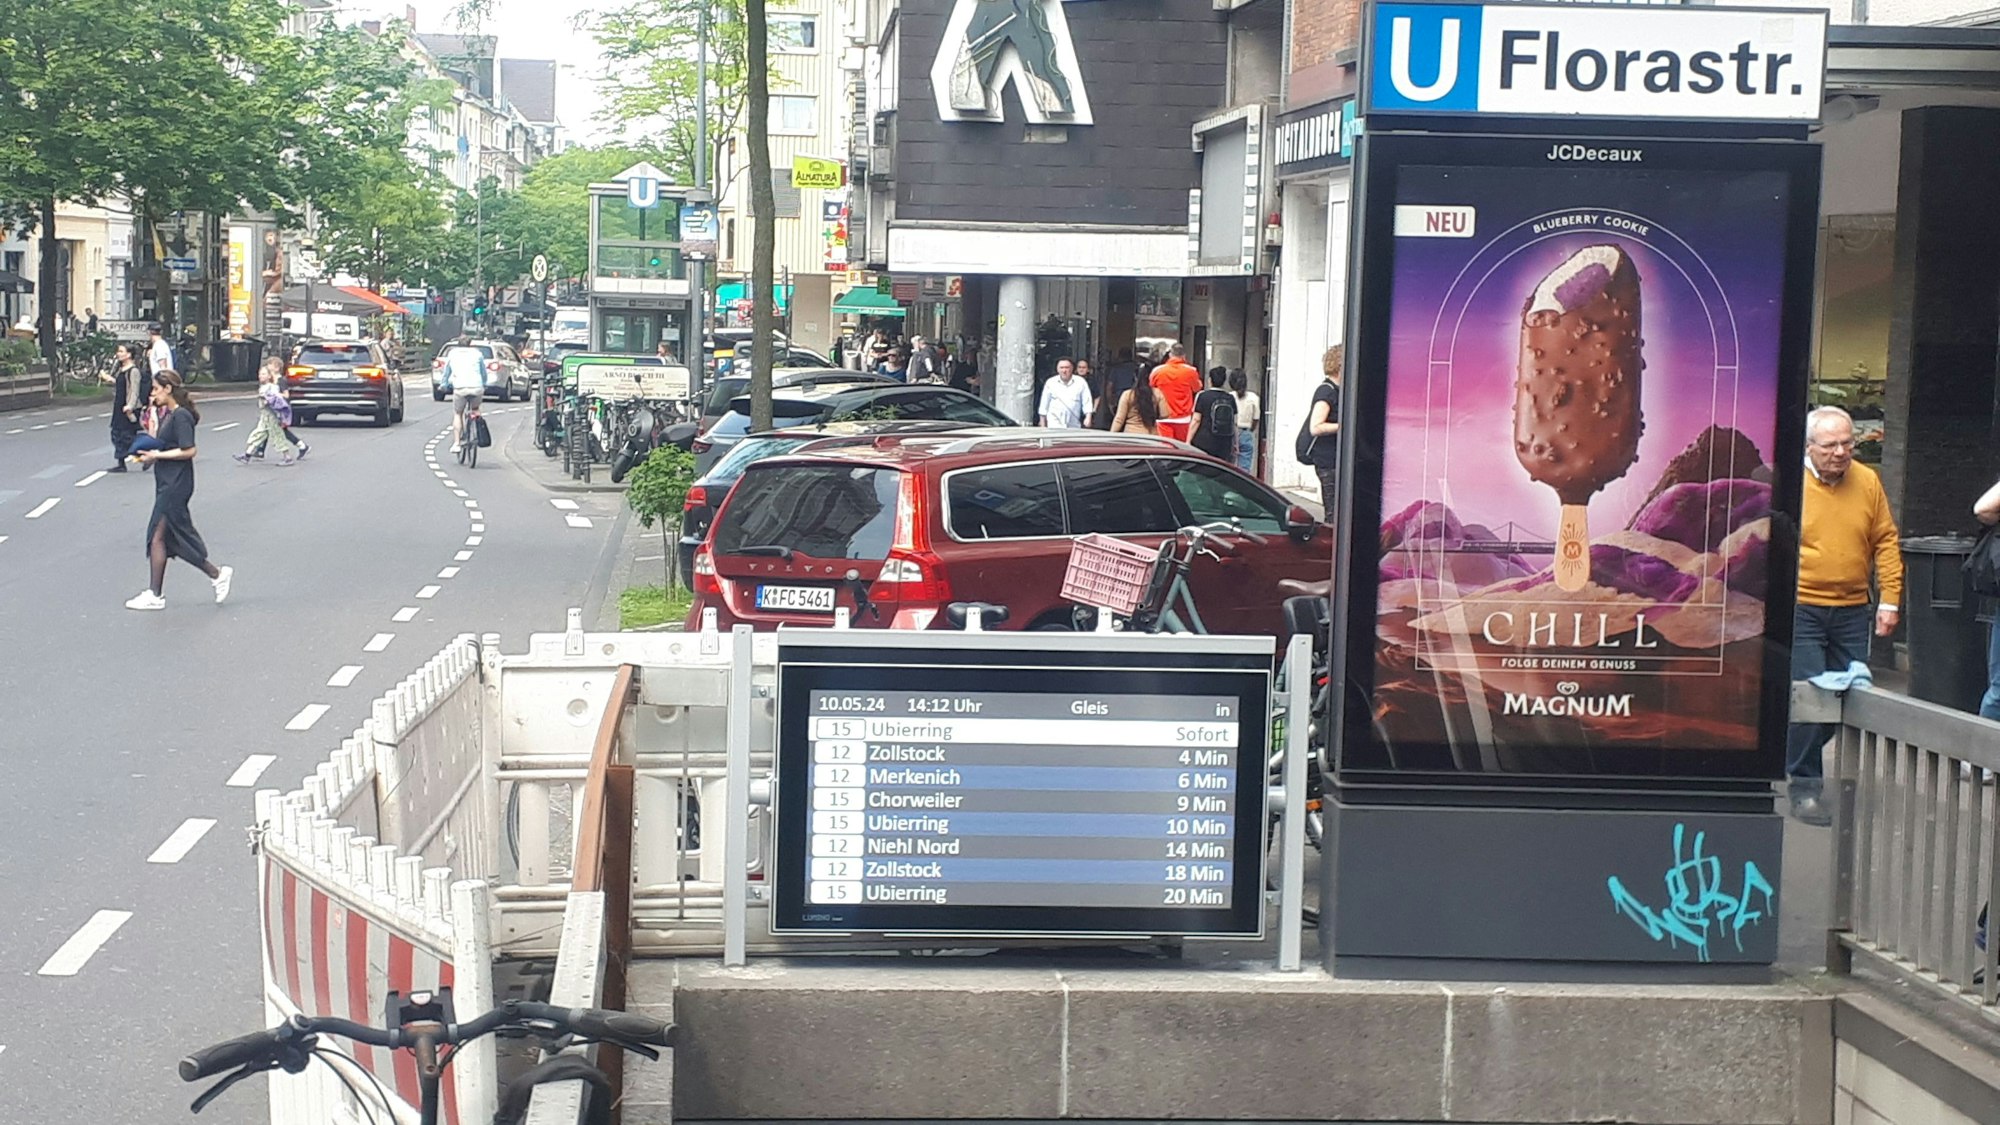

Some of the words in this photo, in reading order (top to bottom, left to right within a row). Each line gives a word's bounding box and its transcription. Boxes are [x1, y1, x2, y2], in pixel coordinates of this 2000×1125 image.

[1390, 16, 1460, 101] U
[1500, 30, 1802, 95] Florastr.
[1275, 110, 1342, 166] DIGITALDRUCK
[1547, 144, 1642, 162] JCDecaux
[629, 177, 657, 207] U
[1425, 211, 1467, 233] NEU
[1532, 214, 1599, 234] BLUEBERRY
[1603, 215, 1649, 236] COOKIE
[748, 563, 834, 574] VOLVO
[763, 588, 772, 605] K
[779, 589, 796, 606] FC
[798, 590, 830, 608] 5461
[1482, 611, 1658, 648] CHILL
[1501, 658, 1538, 669] FOLGE
[1542, 658, 1586, 670] DEINEM
[1590, 659, 1636, 670] GENUSS
[819, 696, 885, 712] 10.05.24
[907, 698, 950, 713] 14:12
[954, 698, 983, 713] Uhr
[1071, 700, 1109, 716] Gleis
[1215, 702, 1230, 717] in
[1502, 692, 1633, 718] MAGNUM
[831, 722, 851, 736] 15
[871, 722, 953, 741] Ubierring
[1176, 726, 1229, 742] Sofort
[831, 745, 851, 759] 12
[869, 745, 946, 762] Zollstock
[1178, 750, 1191, 765] 4
[1194, 750, 1229, 766] Min
[830, 769, 850, 783] 12
[870, 768, 961, 785] Merkenich
[1178, 773, 1190, 789] 6
[1194, 773, 1228, 789] Min
[830, 792, 850, 806] 15
[868, 791, 963, 808] Chorweiler
[1177, 796, 1189, 812] 9
[1192, 796, 1227, 812] Min
[829, 816, 849, 830] 15
[868, 815, 949, 834] Ubierring
[1166, 819, 1189, 835] 10
[1192, 819, 1226, 835] Min
[828, 839, 848, 853] 12
[868, 838, 912, 854] Niehl
[917, 838, 960, 855] Nord
[1165, 842, 1188, 858] 14
[1191, 842, 1225, 858] Min
[828, 862, 847, 876] 12
[866, 861, 942, 878] Zollstock
[1164, 865, 1187, 881] 18
[1190, 865, 1224, 882] Min
[827, 886, 847, 900] 15
[866, 885, 947, 904] Ubierring
[1163, 888, 1186, 904] 20
[1190, 888, 1223, 905] Min
